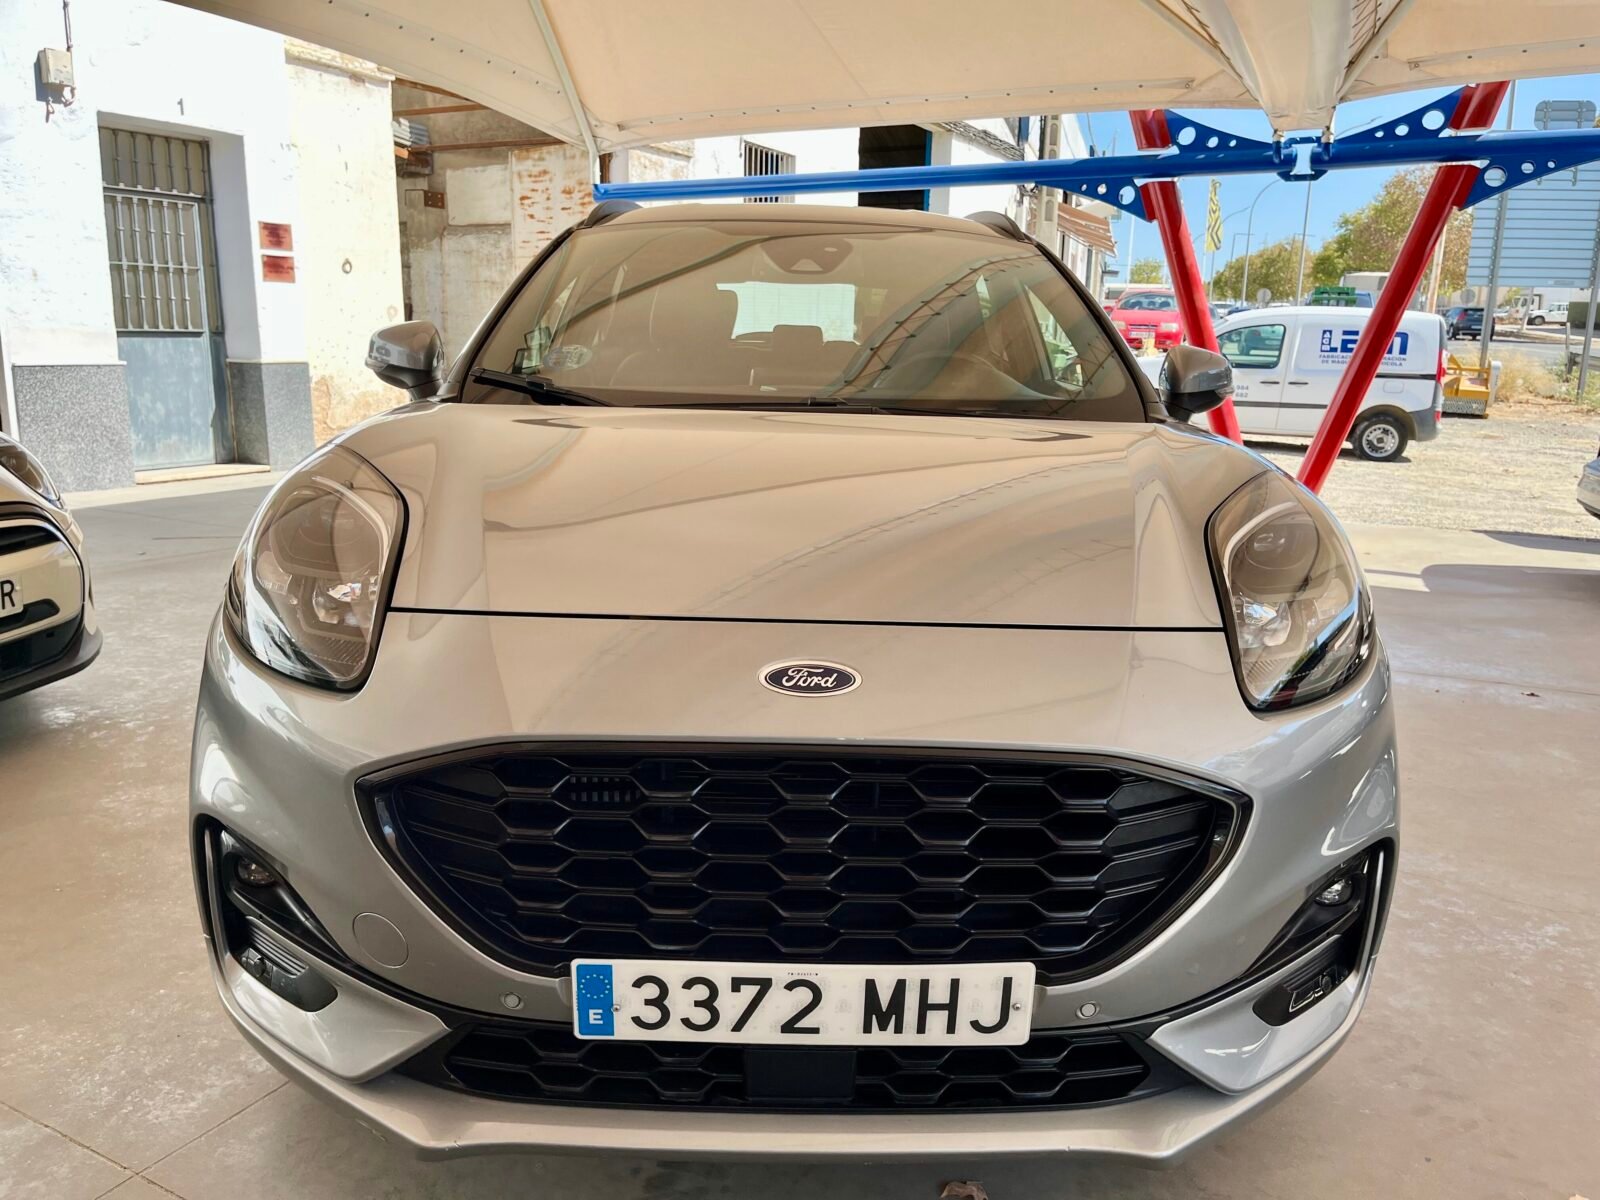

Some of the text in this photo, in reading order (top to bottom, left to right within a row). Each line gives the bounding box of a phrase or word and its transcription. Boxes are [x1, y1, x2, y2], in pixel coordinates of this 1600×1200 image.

[782, 667, 838, 688] Ford
[630, 974, 1014, 1035] 3372 MHJ
[588, 1008, 604, 1025] E
